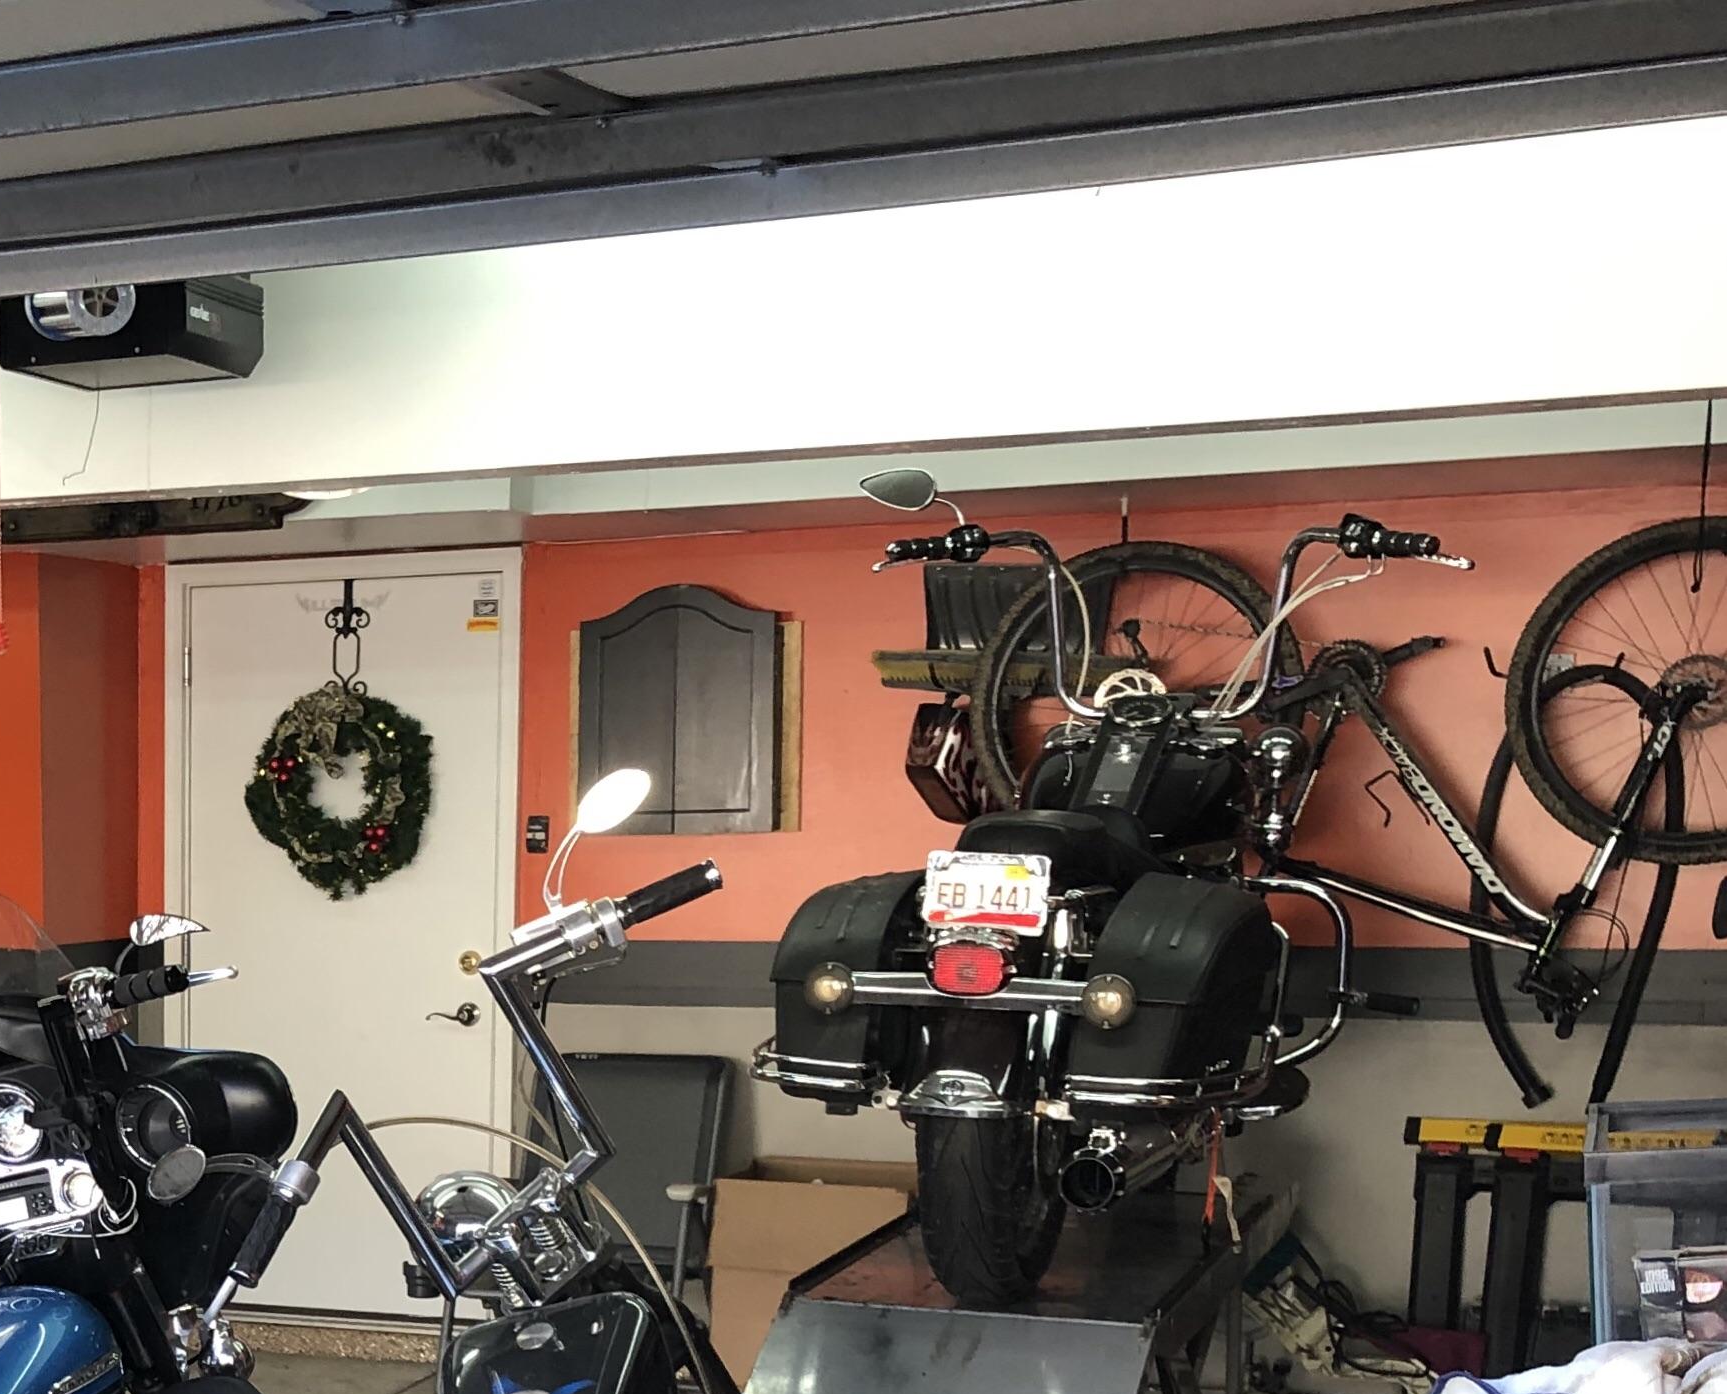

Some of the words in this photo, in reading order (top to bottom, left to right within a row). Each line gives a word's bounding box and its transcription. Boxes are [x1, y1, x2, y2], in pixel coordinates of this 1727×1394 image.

[937, 882, 967, 909] EB
[975, 884, 1031, 911] 1441
[1639, 1279, 1676, 1295] EDITION
